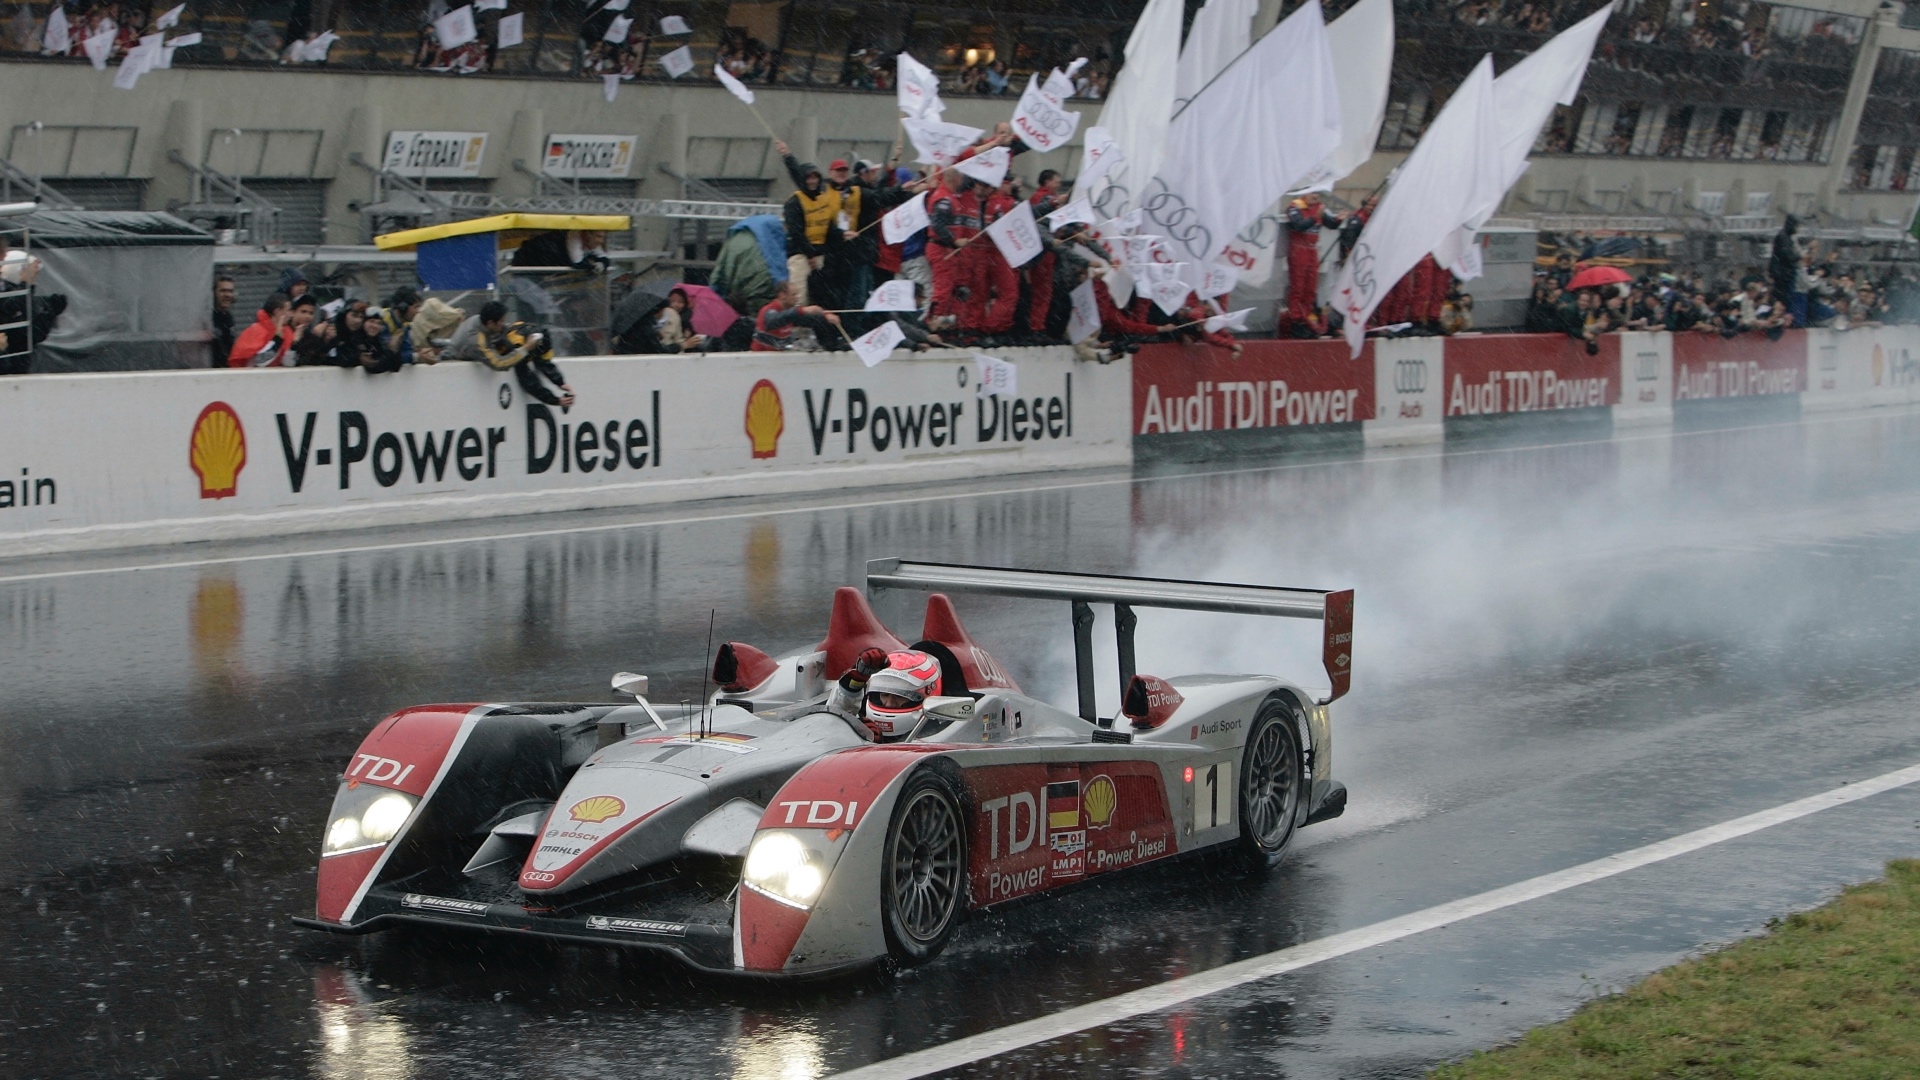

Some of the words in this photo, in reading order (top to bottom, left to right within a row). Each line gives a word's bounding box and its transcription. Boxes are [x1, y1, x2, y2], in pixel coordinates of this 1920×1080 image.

[1016, 116, 1052, 147] Audi
[405, 139, 467, 168] FERRARI
[562, 141, 616, 168] PORSCHE
[1447, 370, 1503, 417] Audi
[1503, 370, 1539, 412] TDI
[1541, 369, 1609, 410] Power
[1676, 361, 1717, 400] Audi
[1747, 360, 1799, 396] Power
[803, 388, 964, 456] V-Power
[976, 371, 1073, 443] Diesel
[1140, 381, 1213, 435] Audi
[1217, 381, 1267, 429] TDI
[1269, 379, 1359, 427] Power
[1398, 402, 1423, 419] Audi
[274, 411, 507, 493] V-Power
[525, 389, 661, 475] Diesel
[1335, 631, 1352, 645] BOSCH
[1145, 679, 1162, 692] Audi
[1147, 693, 1161, 708] TDI
[1161, 692, 1181, 706] Power
[1200, 722, 1219, 735] Audi
[1220, 718, 1242, 733] Sport
[350, 753, 416, 786] TDI
[1206, 764, 1218, 828] 1
[780, 801, 858, 825] TDI
[981, 786, 1048, 860] TDI
[560, 831, 600, 842] BOSCH
[1070, 833, 1083, 844] 01
[1137, 833, 1166, 859] Diesel
[540, 845, 582, 856] MAHLE
[1052, 857, 1083, 870] LMP1
[989, 865, 1046, 899] Power
[422, 898, 488, 911] MICHELIN
[611, 919, 685, 931] MICHELIN
